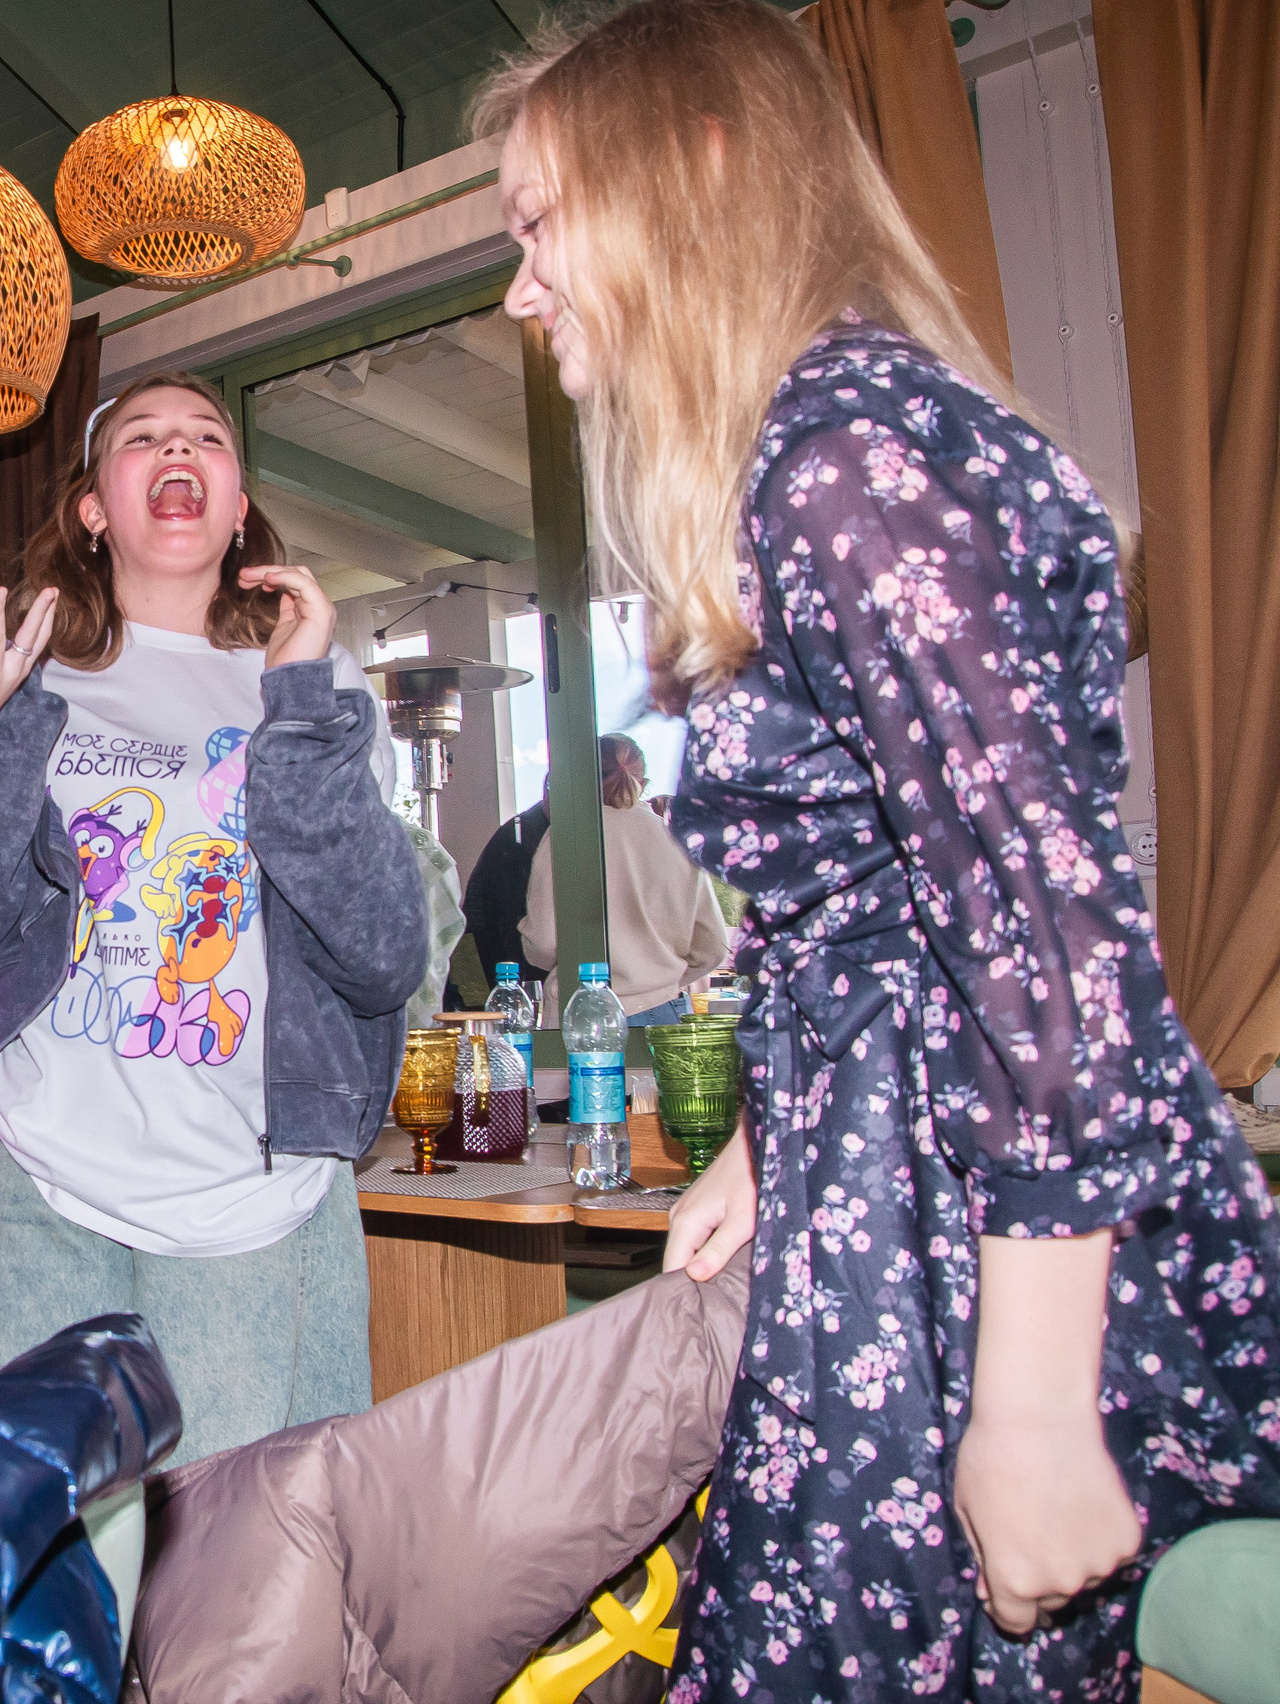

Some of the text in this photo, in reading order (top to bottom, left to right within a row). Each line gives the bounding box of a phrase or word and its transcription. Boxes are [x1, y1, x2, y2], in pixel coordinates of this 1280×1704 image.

[61, 732, 188, 759] МОЕ СЕРДЦЕ
[54, 750, 186, 780] БЬЕТСЯ
